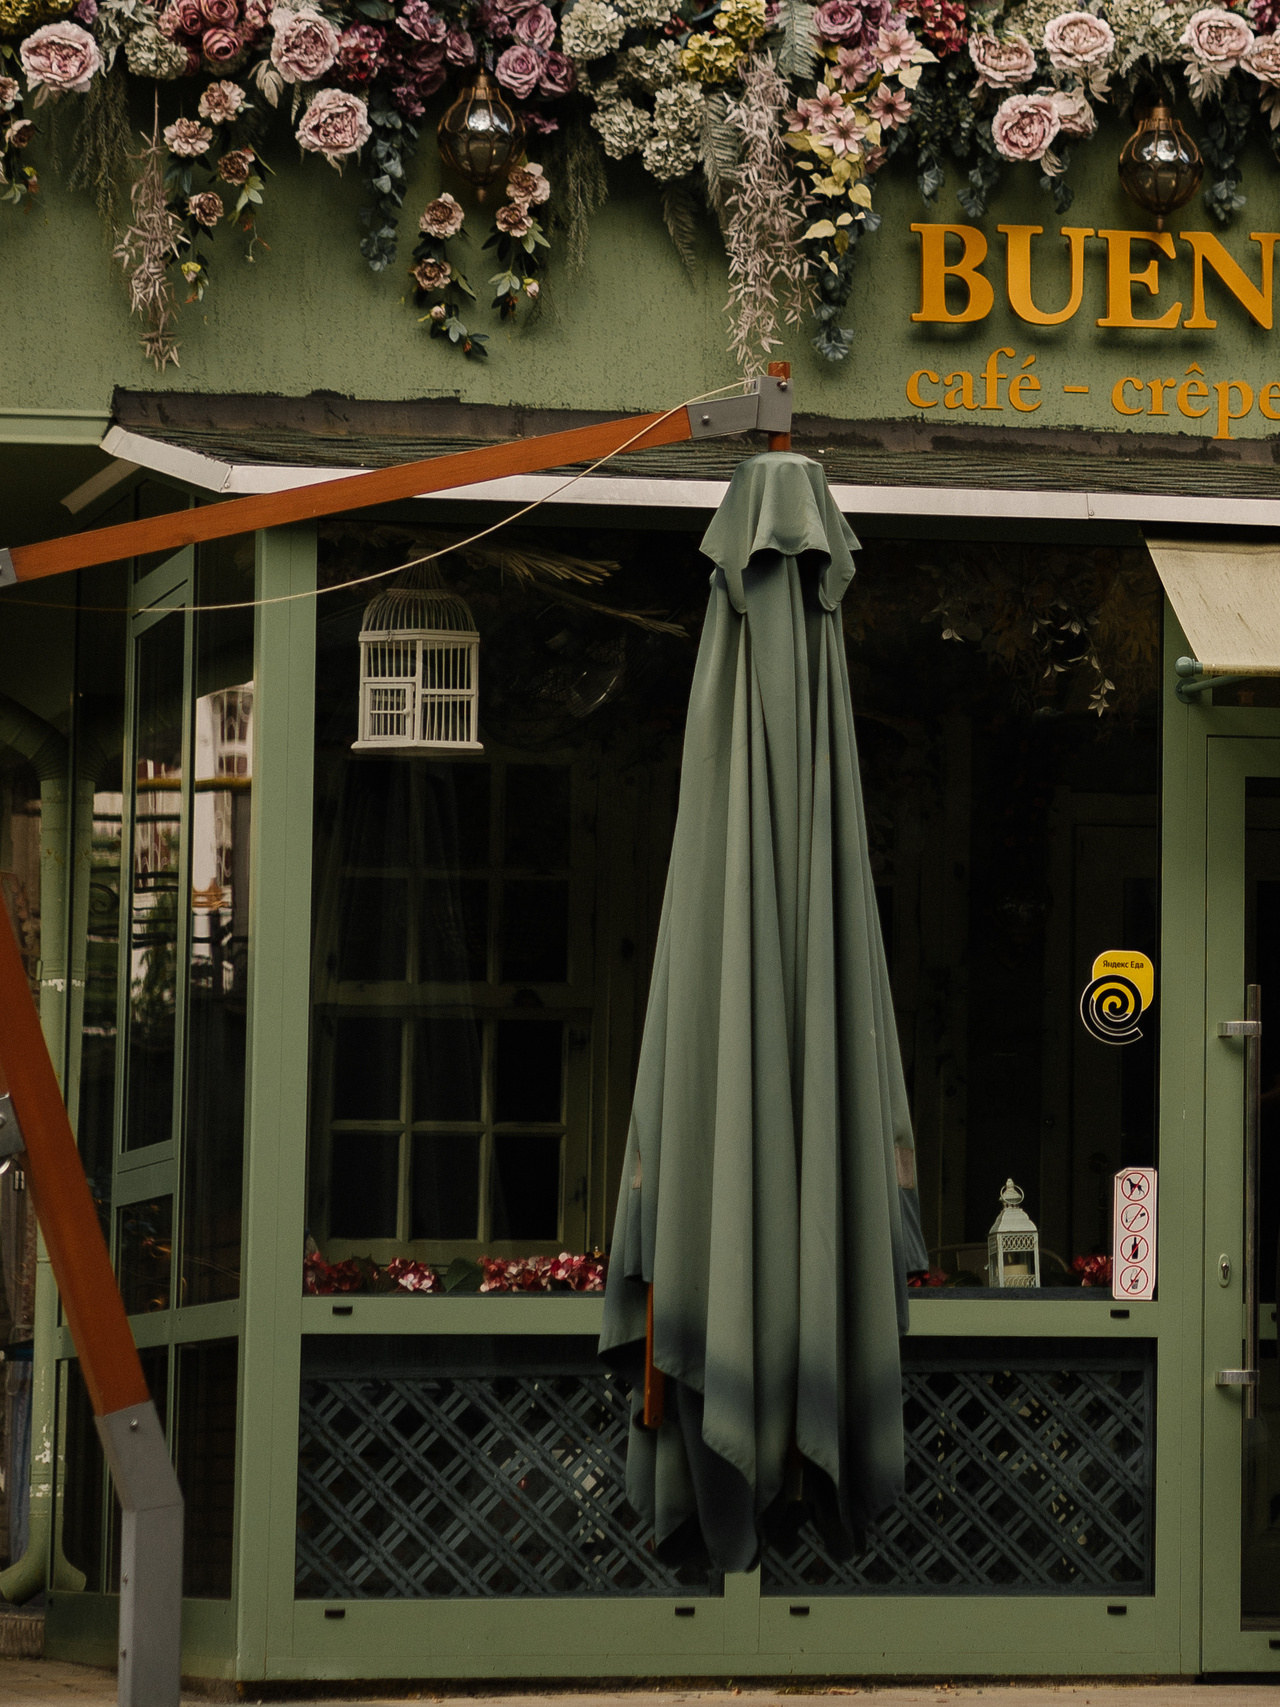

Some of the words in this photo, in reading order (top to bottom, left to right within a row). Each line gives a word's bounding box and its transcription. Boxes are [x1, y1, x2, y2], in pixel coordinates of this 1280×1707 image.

[906, 347, 1042, 412] café
[1102, 960, 1129, 969] Яндекс
[1130, 960, 1144, 969] Еда
